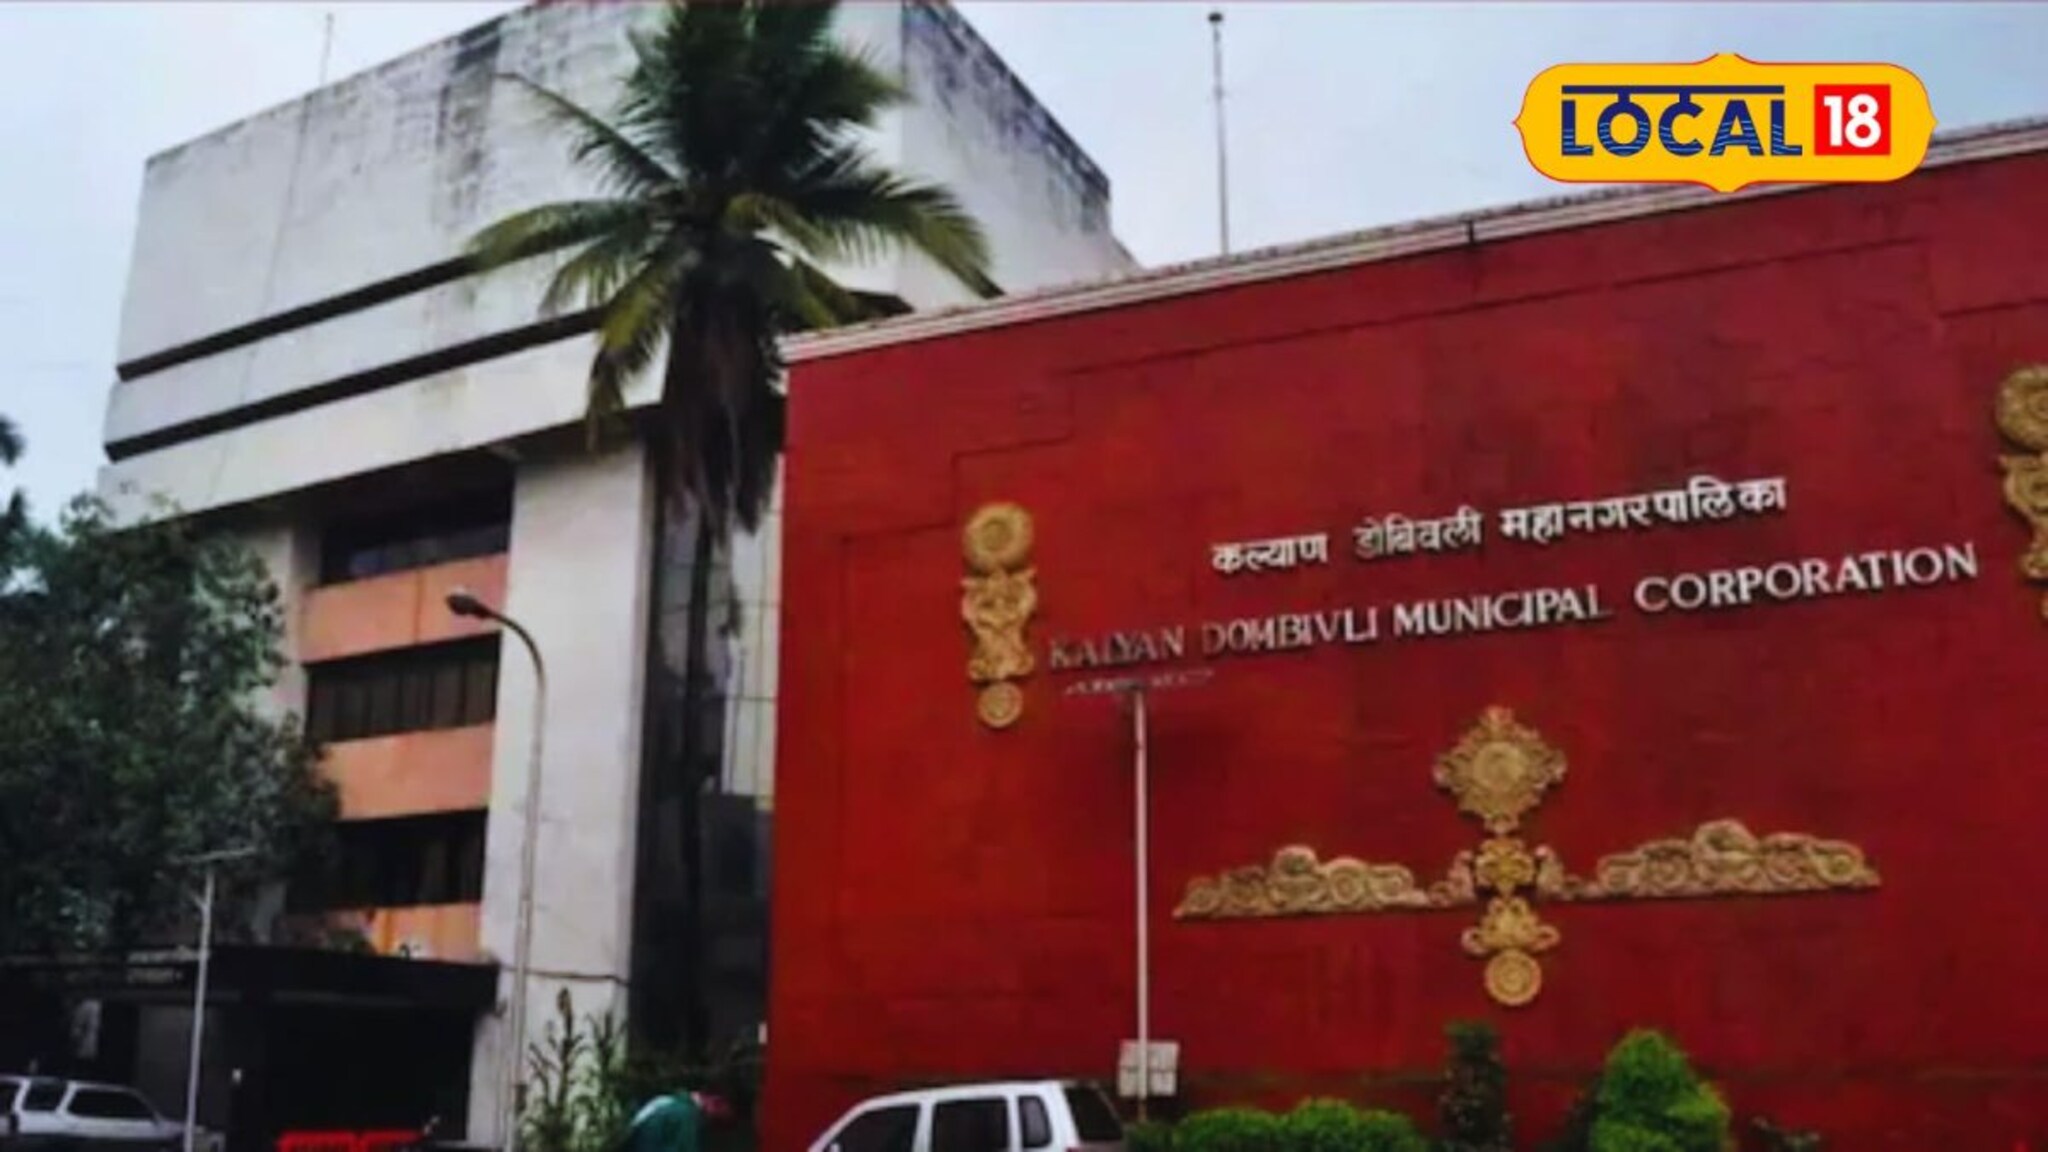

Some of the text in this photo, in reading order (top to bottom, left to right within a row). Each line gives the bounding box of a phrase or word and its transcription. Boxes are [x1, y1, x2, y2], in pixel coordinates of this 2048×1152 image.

[1211, 532, 1328, 574] कल्याण
[1499, 476, 1787, 542] महानगरपालिका
[1050, 542, 1979, 669] KALYAN DOMBIVLI MUNICIPAL CORPORATION
